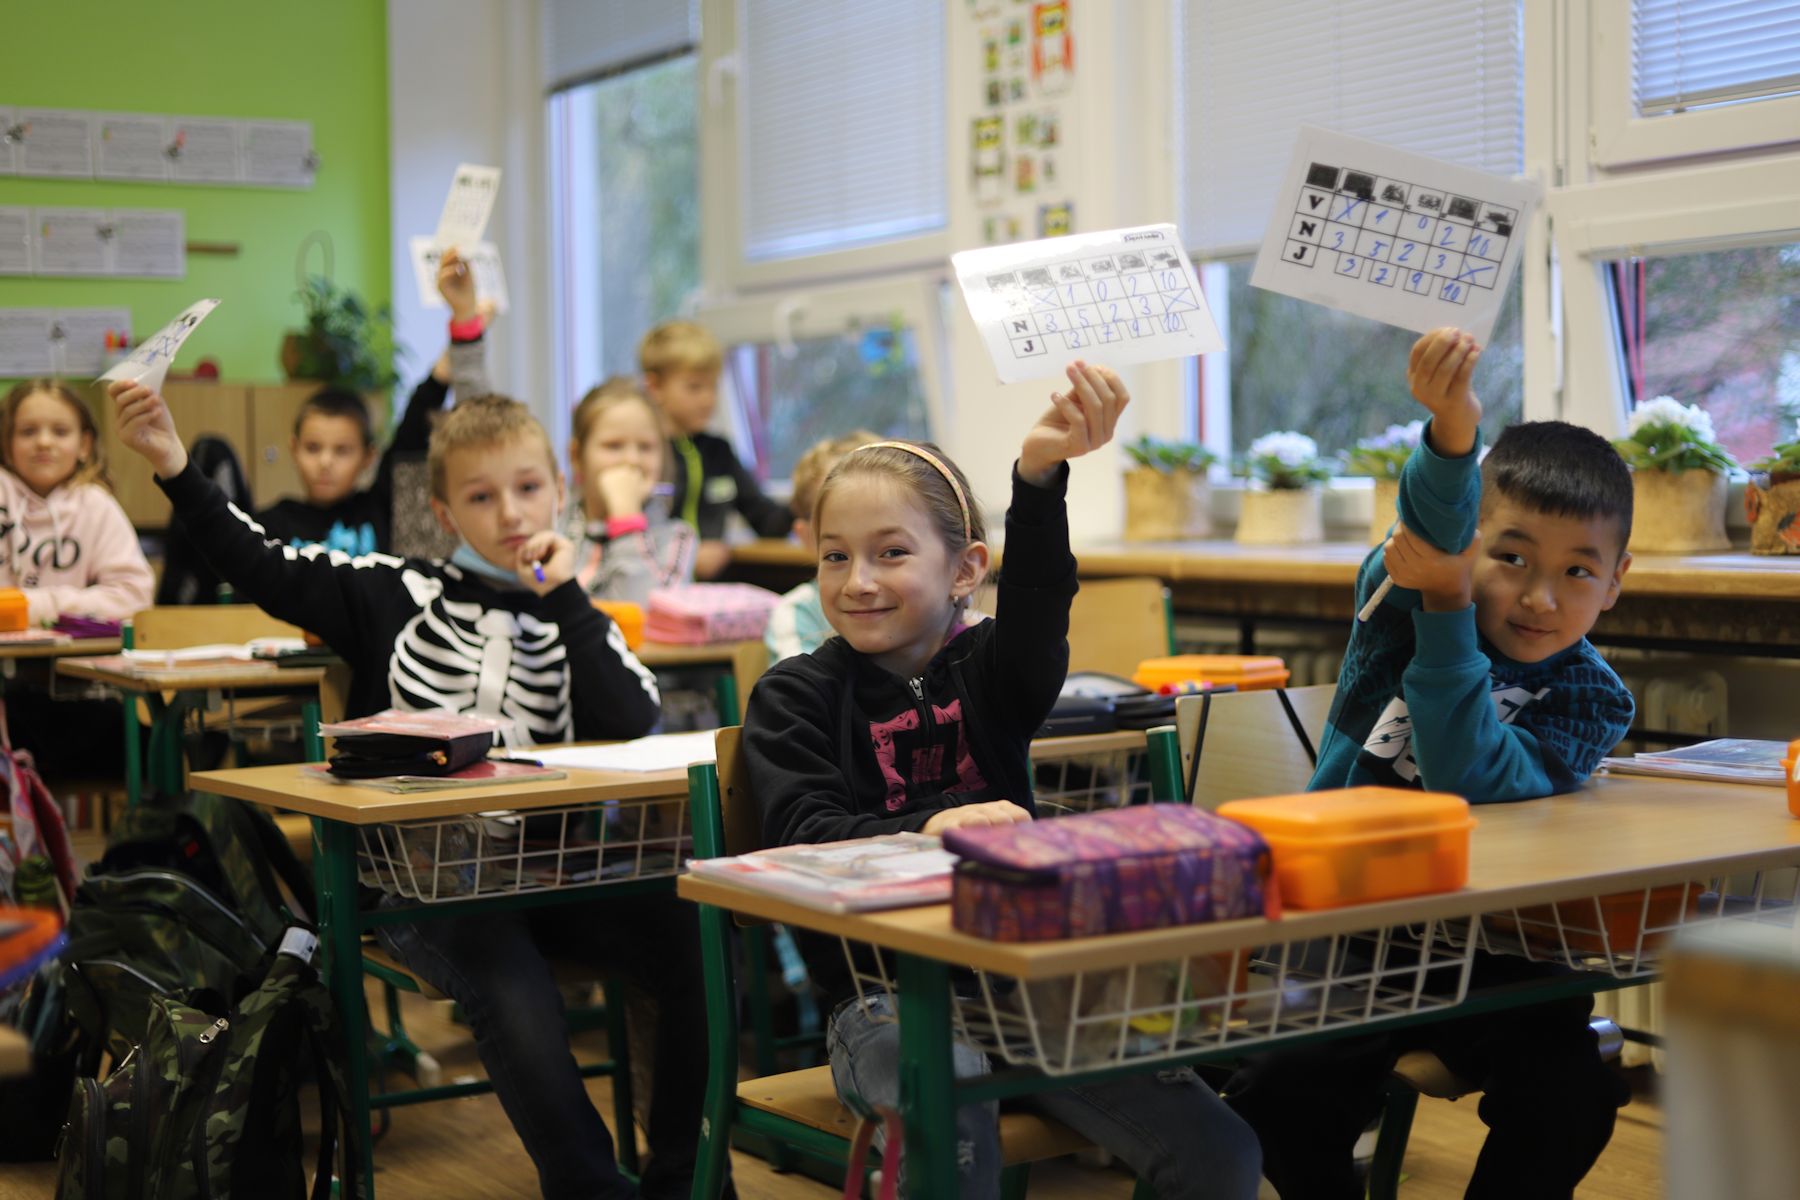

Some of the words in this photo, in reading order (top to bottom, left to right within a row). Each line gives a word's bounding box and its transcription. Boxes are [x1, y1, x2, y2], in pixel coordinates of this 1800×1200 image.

[1309, 194, 1325, 210] V
[1298, 220, 1317, 237] N
[1417, 215, 1429, 229] 0
[1440, 226, 1456, 246] 2
[1293, 246, 1308, 260] J
[1331, 231, 1345, 250] 3
[1398, 243, 1415, 262] 2
[1434, 254, 1447, 269] 3
[1343, 258, 1356, 272] 3
[1096, 280, 1108, 302] 0
[1160, 272, 1177, 291] 10
[1045, 313, 1058, 333] 3
[1078, 308, 1090, 327] 5
[1109, 303, 1124, 323] 2
[1139, 295, 1152, 315] 3
[1012, 319, 1029, 333] N
[1070, 330, 1081, 349] 3
[1103, 322, 1114, 343] 7
[1164, 312, 1180, 332] 10
[1024, 339, 1034, 352] J
